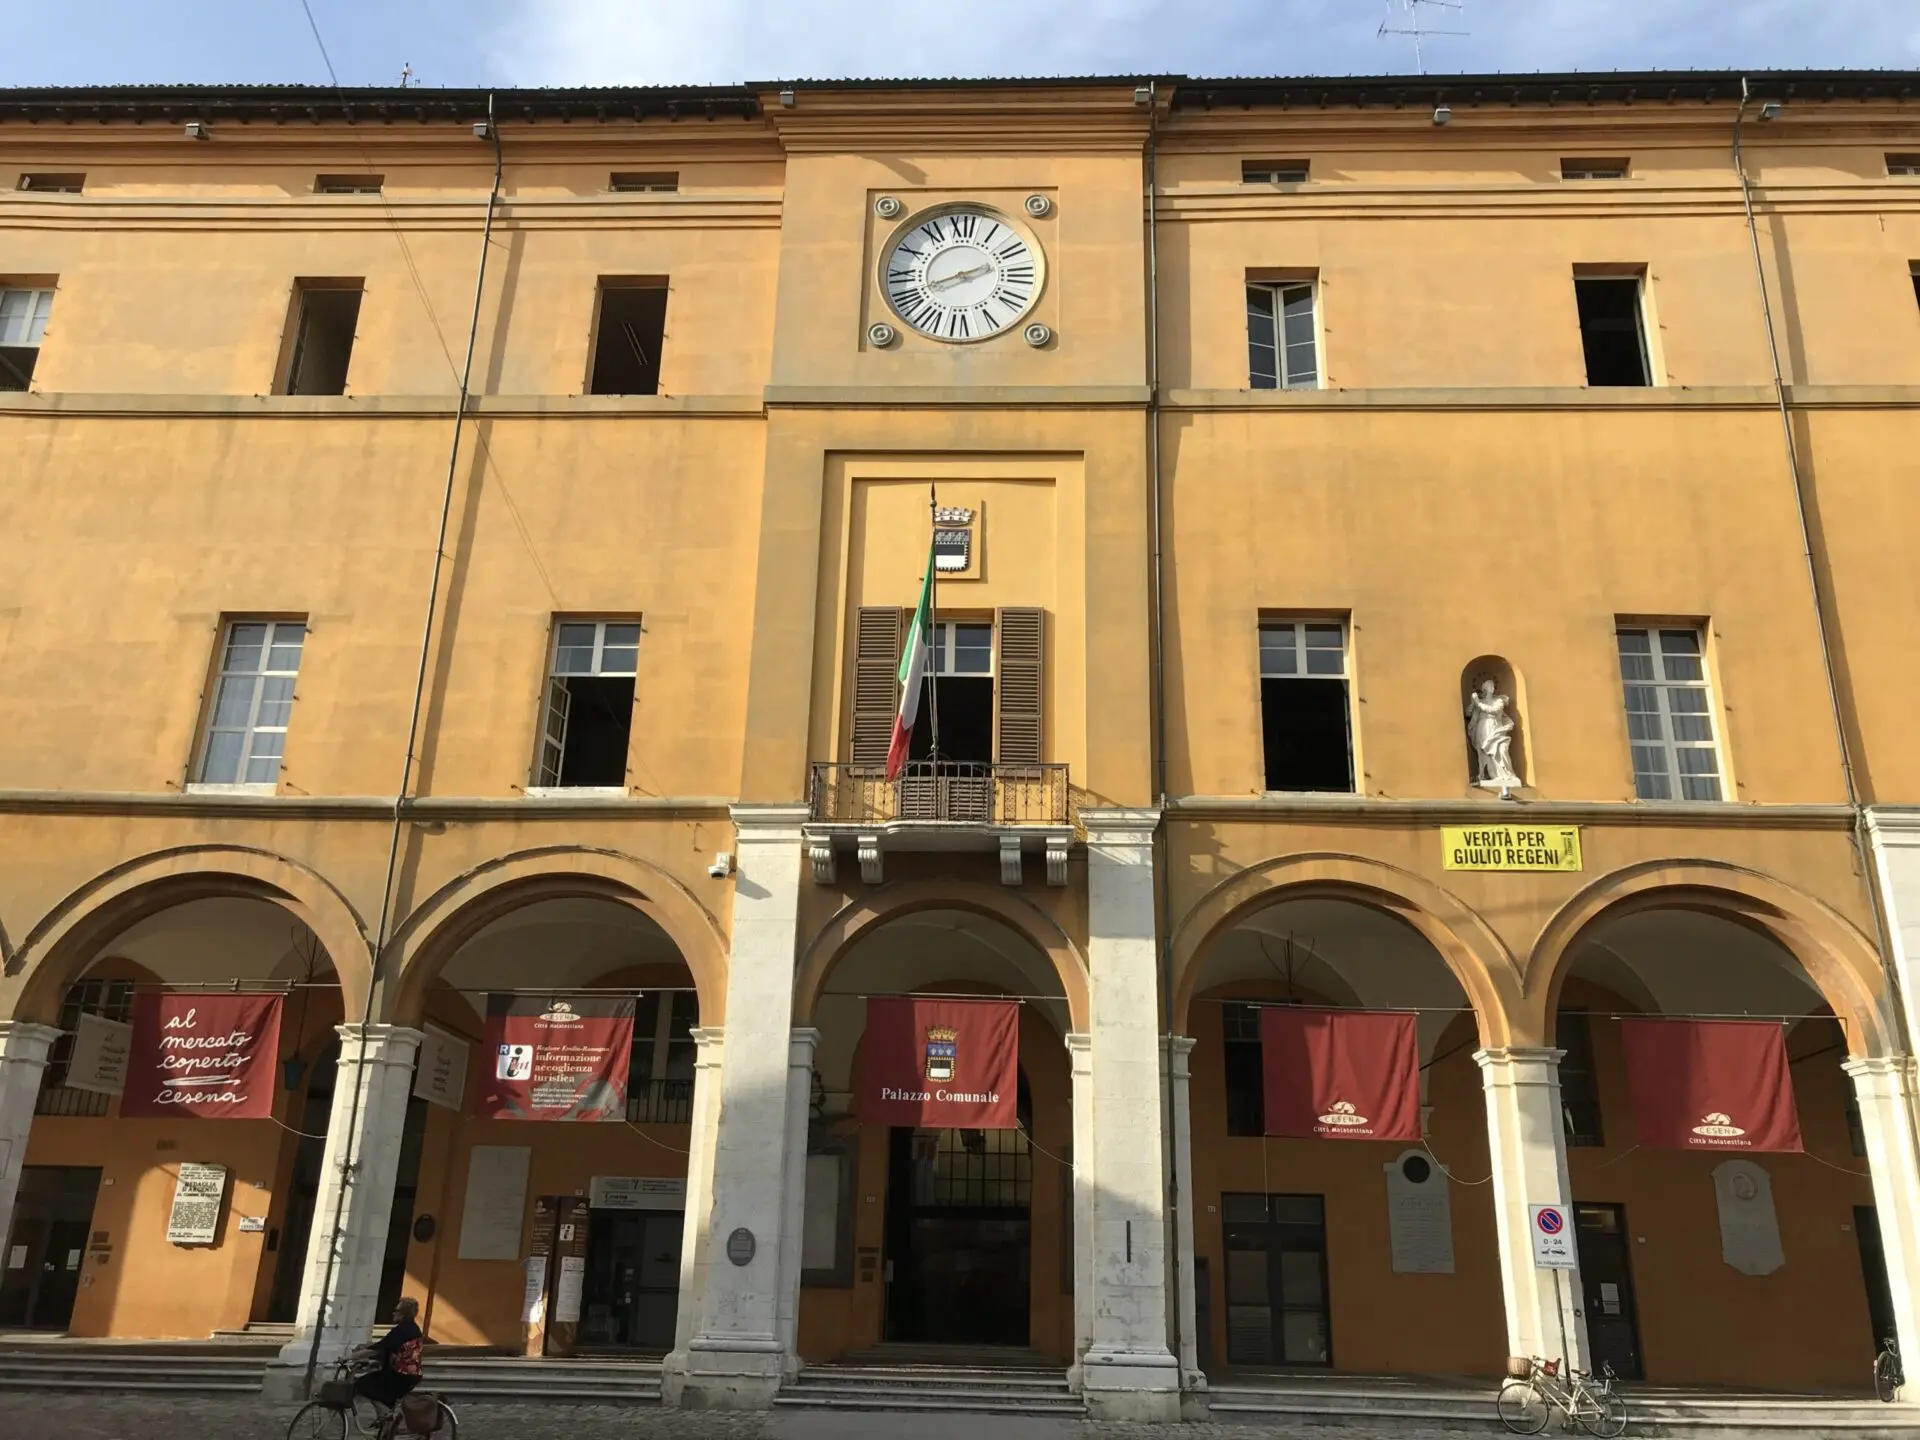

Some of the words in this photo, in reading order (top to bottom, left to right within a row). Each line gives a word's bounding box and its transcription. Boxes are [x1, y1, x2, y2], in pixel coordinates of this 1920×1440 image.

[950, 216, 976, 238] XII
[1463, 828, 1513, 847] VERITÀ
[1517, 831, 1545, 847] PER
[1454, 849, 1502, 864] GIULIO
[1506, 849, 1559, 865] REGENI
[164, 1008, 197, 1029] al
[159, 1030, 252, 1049] mercato
[499, 1044, 508, 1054] R
[156, 1052, 251, 1075] coperto
[535, 1052, 601, 1062] informazione
[534, 1062, 593, 1073] accoglienza
[533, 1073, 575, 1083] turistica
[881, 1088, 931, 1101] Palazzo
[936, 1089, 999, 1103] Comunale
[1708, 1138, 1752, 1146] Malatestiana
